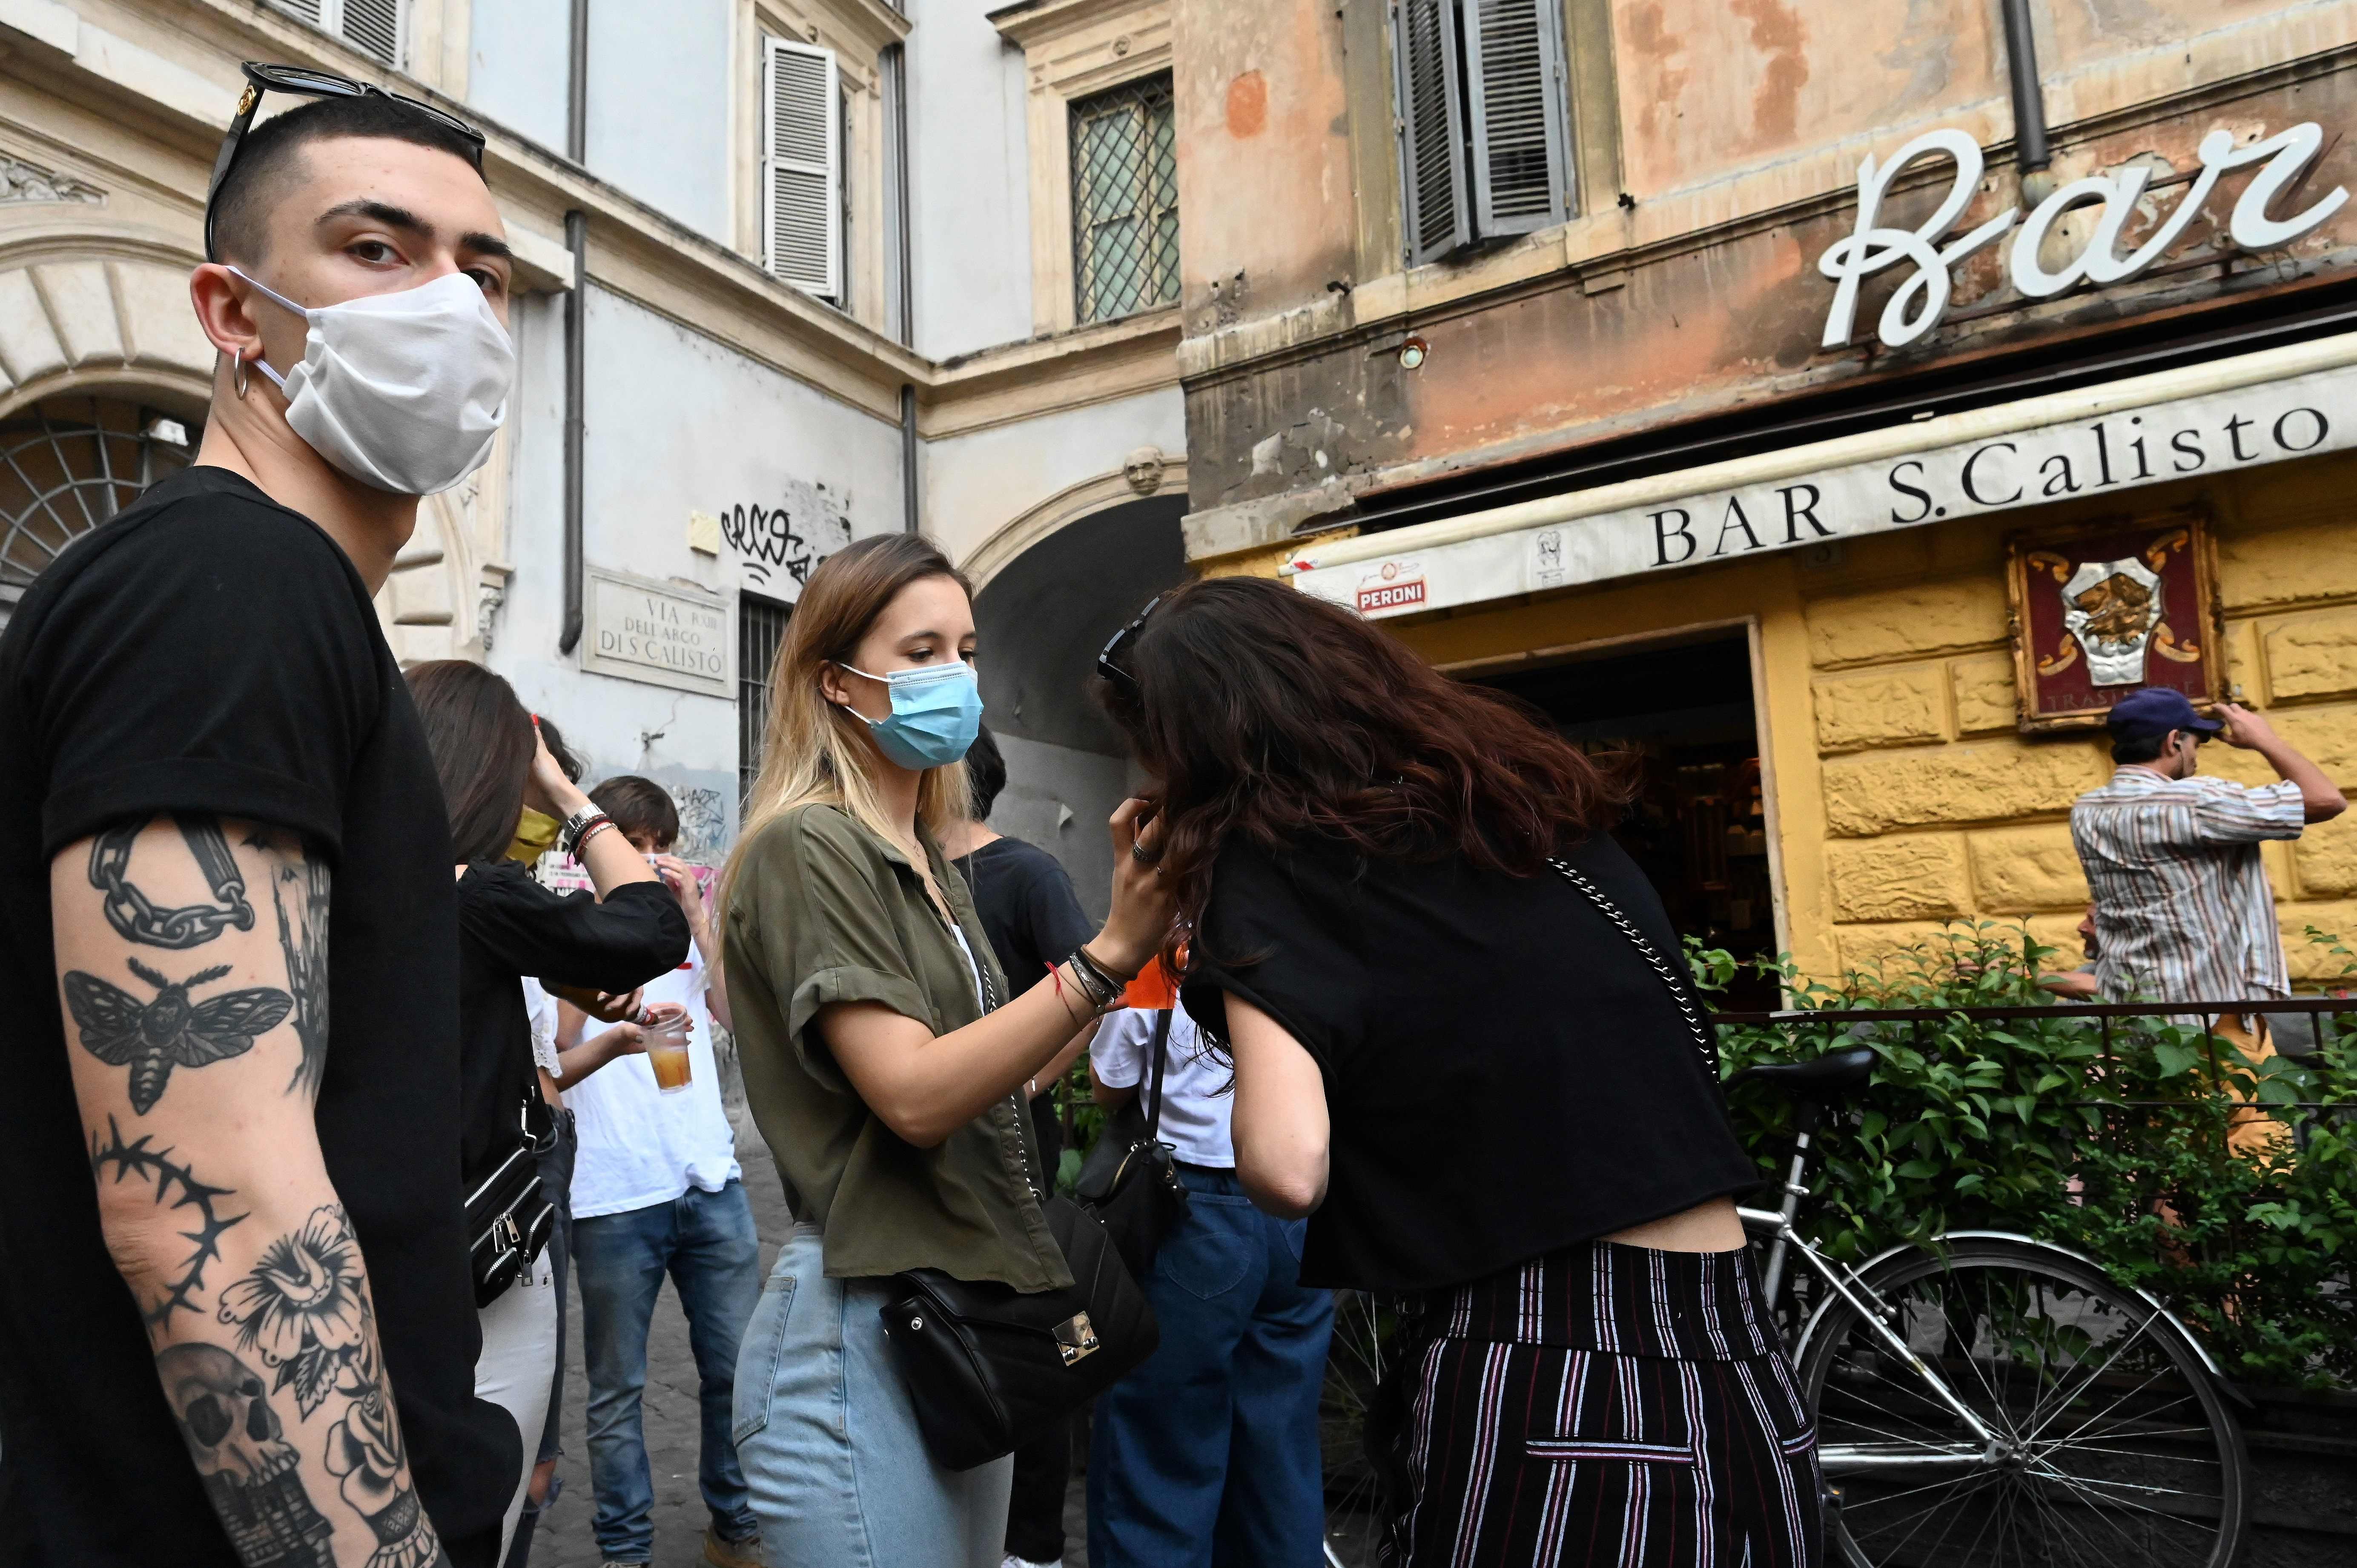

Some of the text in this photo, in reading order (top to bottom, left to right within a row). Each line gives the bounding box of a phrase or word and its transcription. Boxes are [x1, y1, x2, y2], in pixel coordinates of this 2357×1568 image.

[1818, 122, 2350, 347] Bar
[1646, 484, 1837, 567] BAR
[647, 598, 679, 624] VIA
[1361, 585, 1422, 609] PERONI
[602, 630, 622, 653] DI
[645, 640, 721, 672] CALISTO
